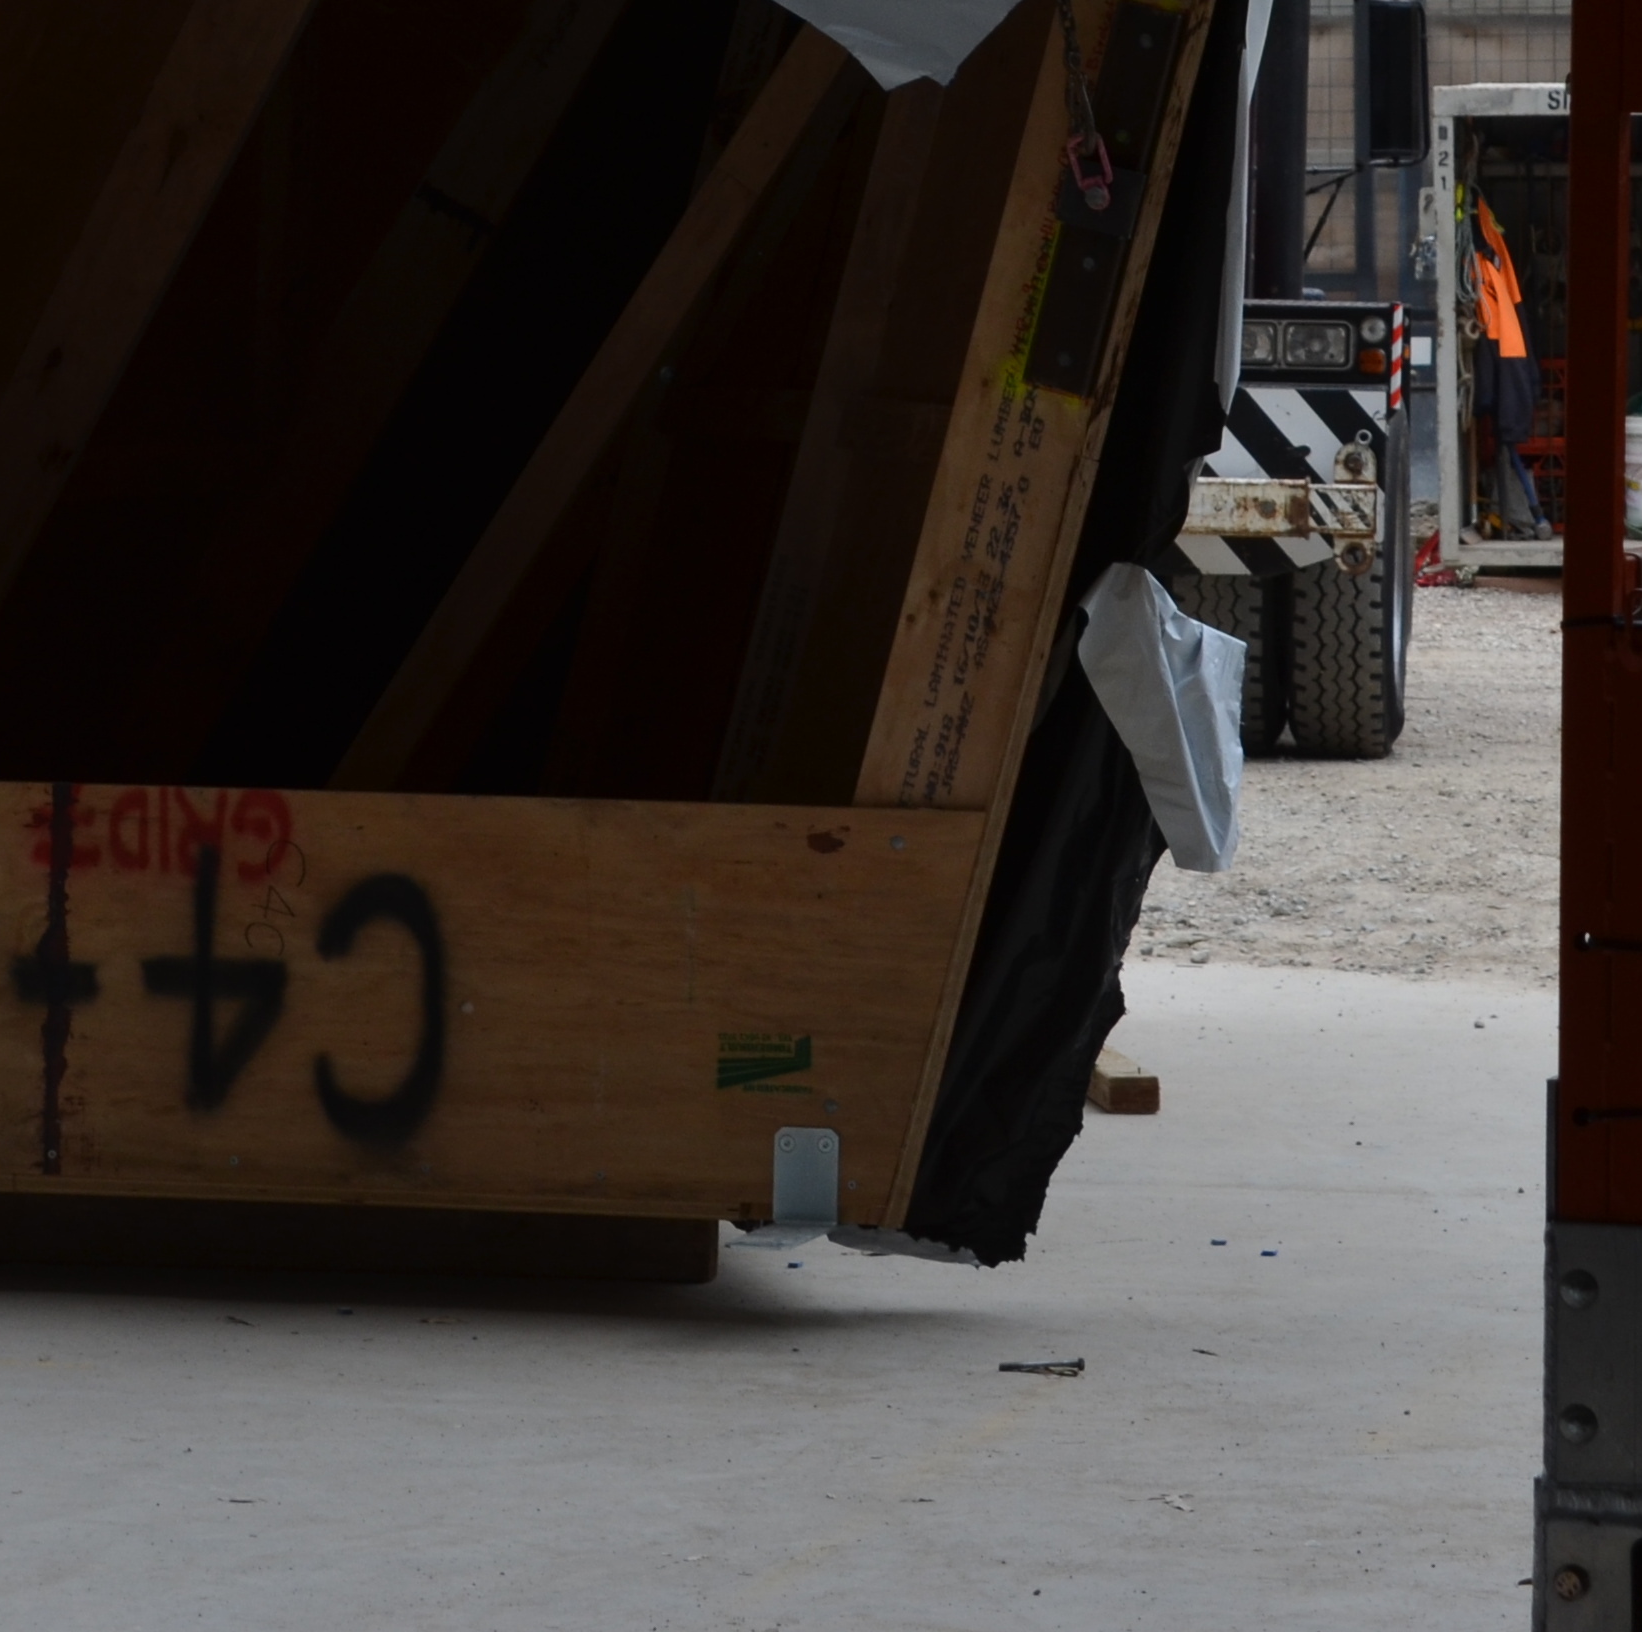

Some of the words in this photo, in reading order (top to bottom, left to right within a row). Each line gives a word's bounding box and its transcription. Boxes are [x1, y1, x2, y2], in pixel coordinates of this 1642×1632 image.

[924, 576, 967, 708] LAMINATED
[962, 473, 994, 567] VENEER
[109, 784, 293, 882] GRID
